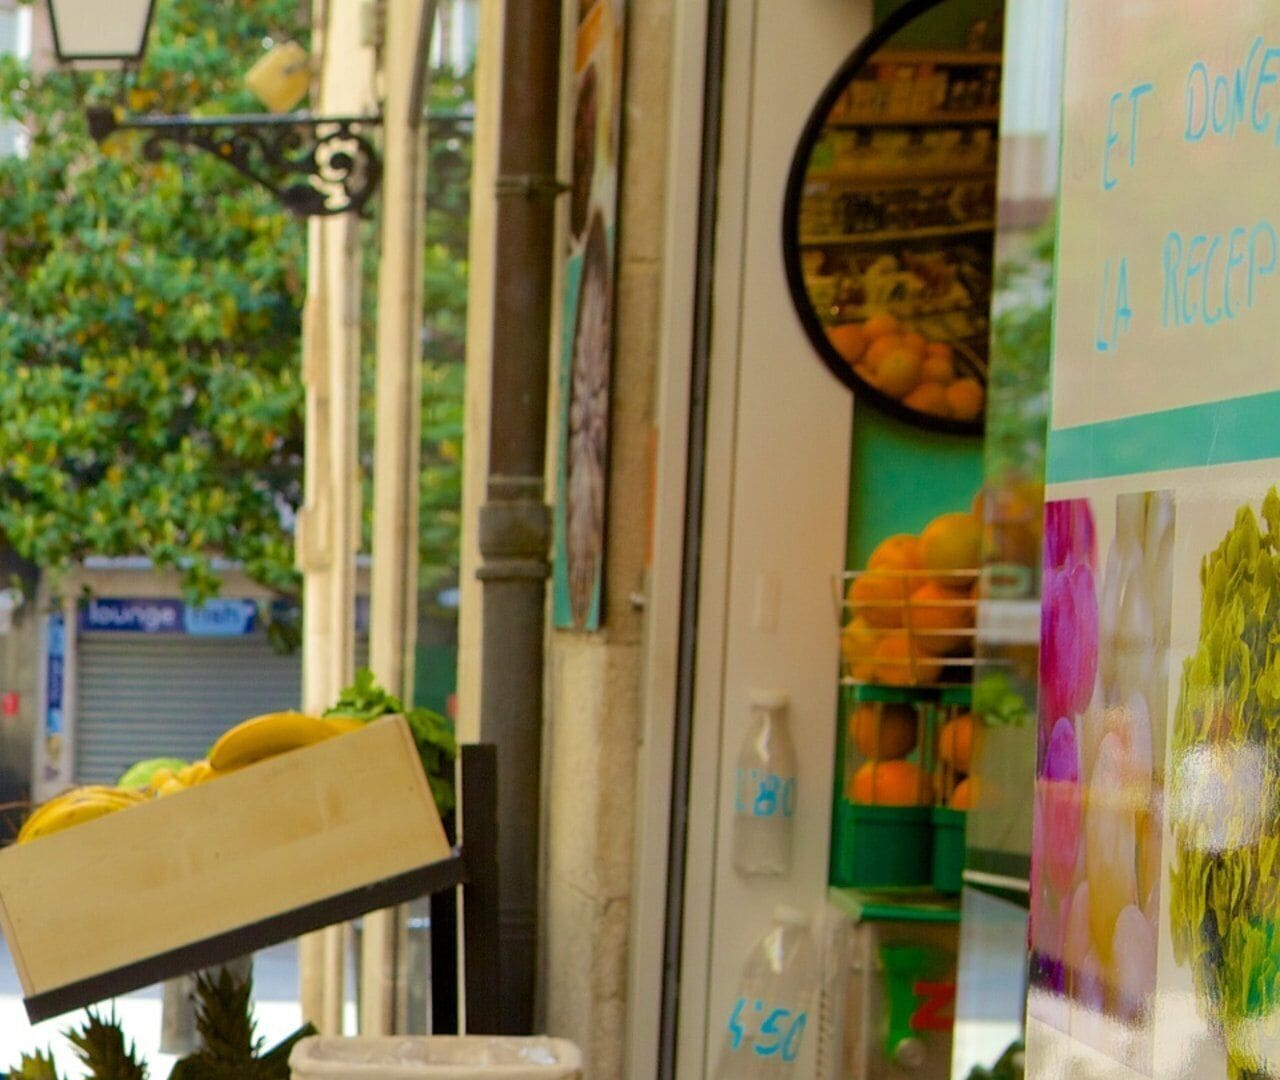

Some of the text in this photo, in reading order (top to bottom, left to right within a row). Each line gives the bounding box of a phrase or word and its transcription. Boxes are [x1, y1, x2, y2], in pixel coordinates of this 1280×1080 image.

[1102, 36, 1280, 190] ET DONE
[1095, 255, 1133, 355] LA
[89, 604, 177, 632] lounge
